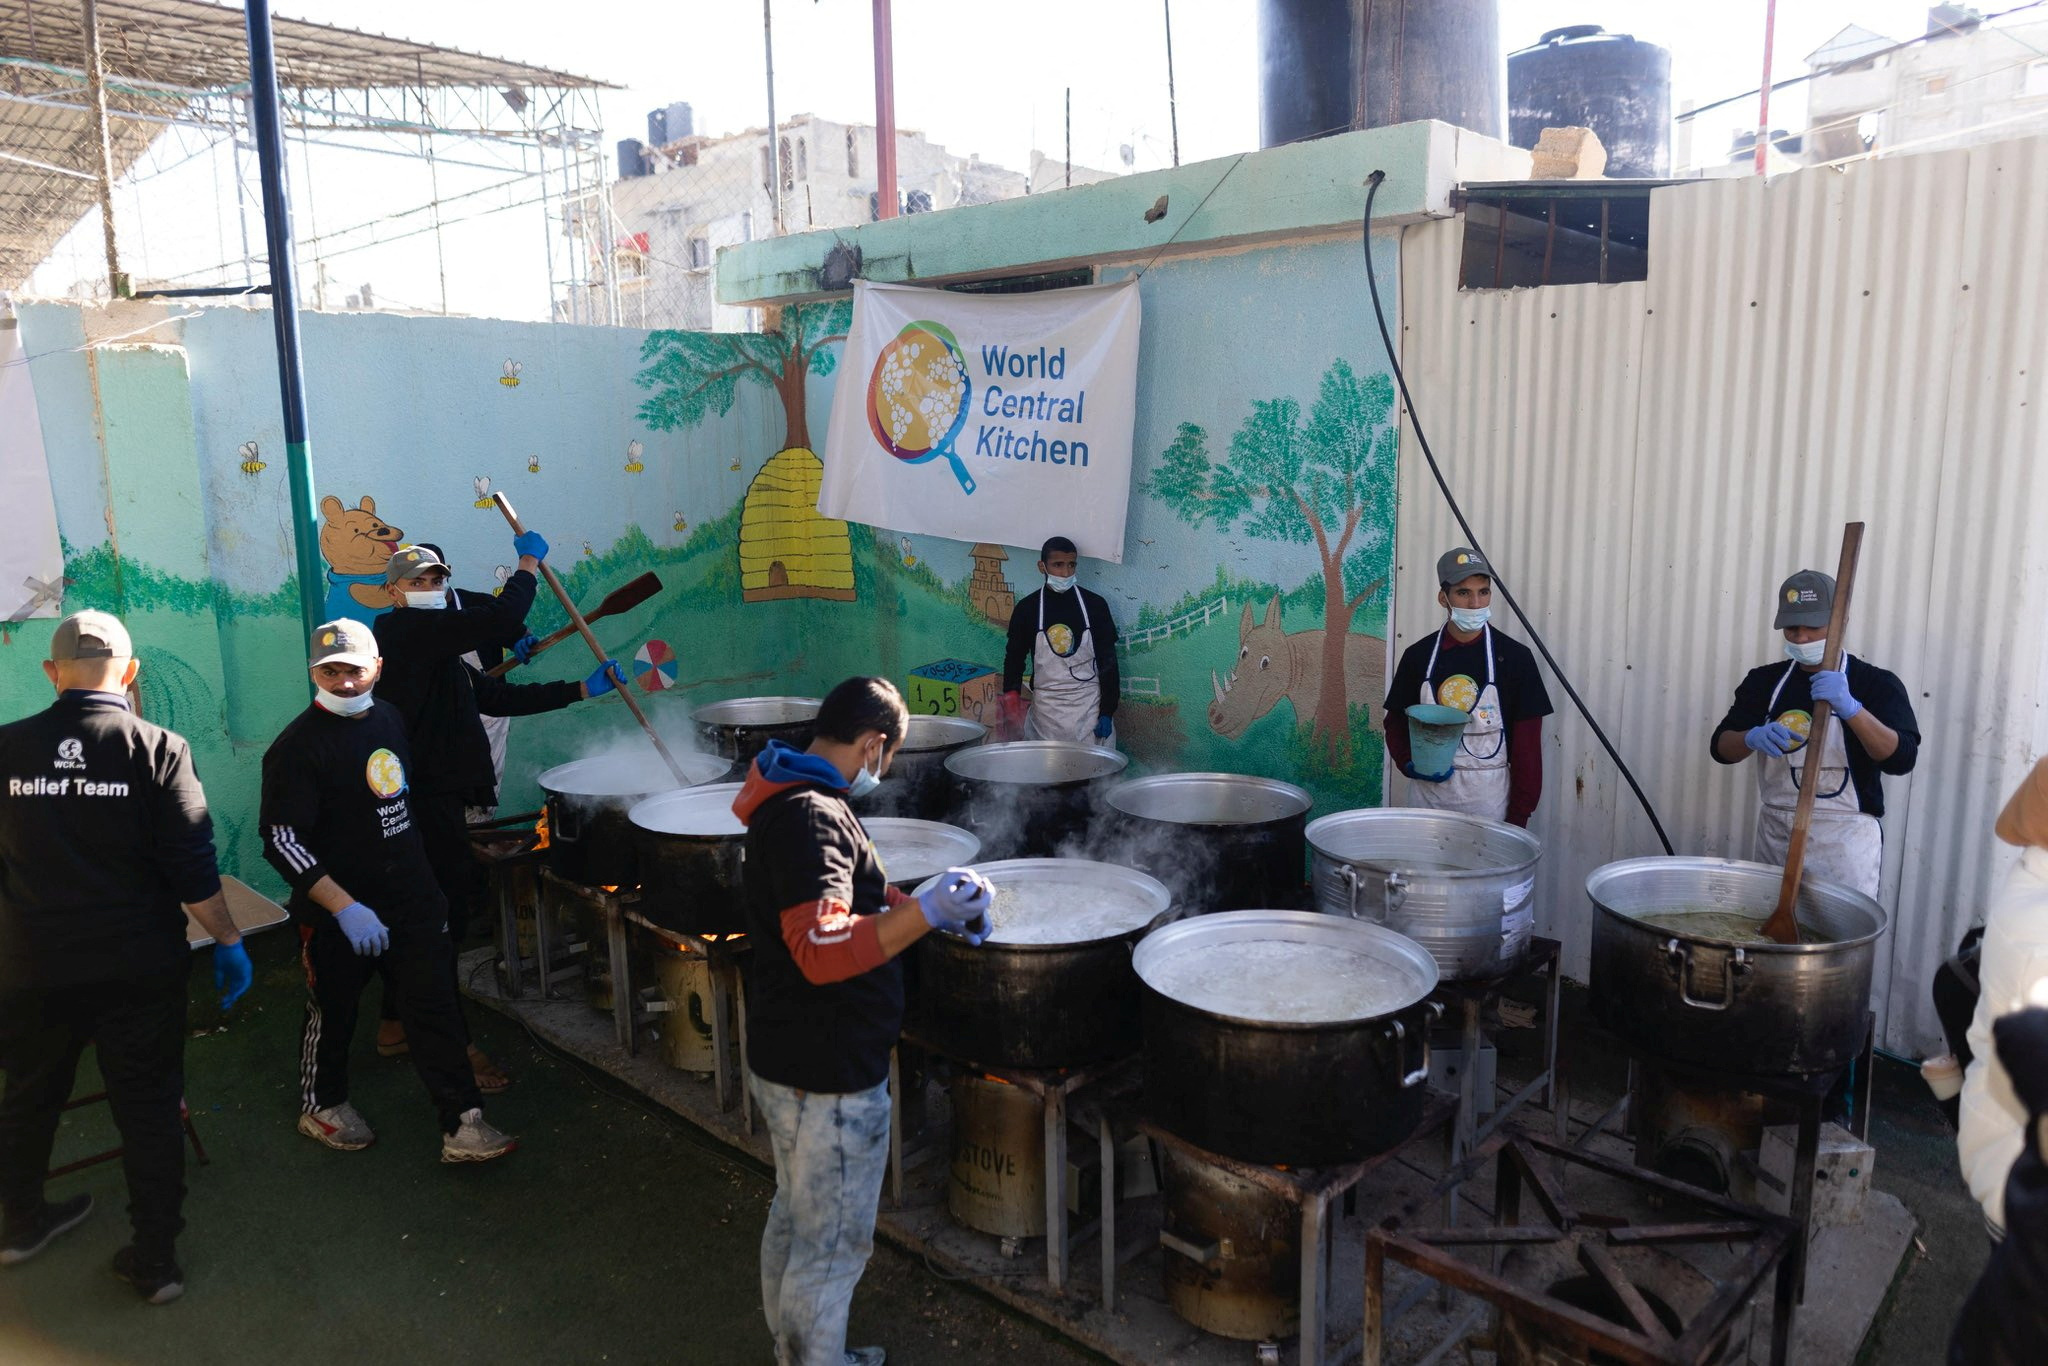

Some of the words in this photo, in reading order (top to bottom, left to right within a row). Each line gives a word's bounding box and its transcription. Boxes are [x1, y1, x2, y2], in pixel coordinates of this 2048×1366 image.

[982, 345, 1066, 380] World
[983, 385, 1085, 424] Central
[975, 425, 1089, 467] Kitchen
[943, 687, 957, 714] 5
[962, 688, 973, 711] 6
[982, 683, 995, 705] 10
[972, 701, 984, 723] 9
[53, 760, 87, 770] WCK.org
[9, 777, 70, 797] Relief
[73, 778, 130, 797] Team
[377, 798, 406, 817] World
